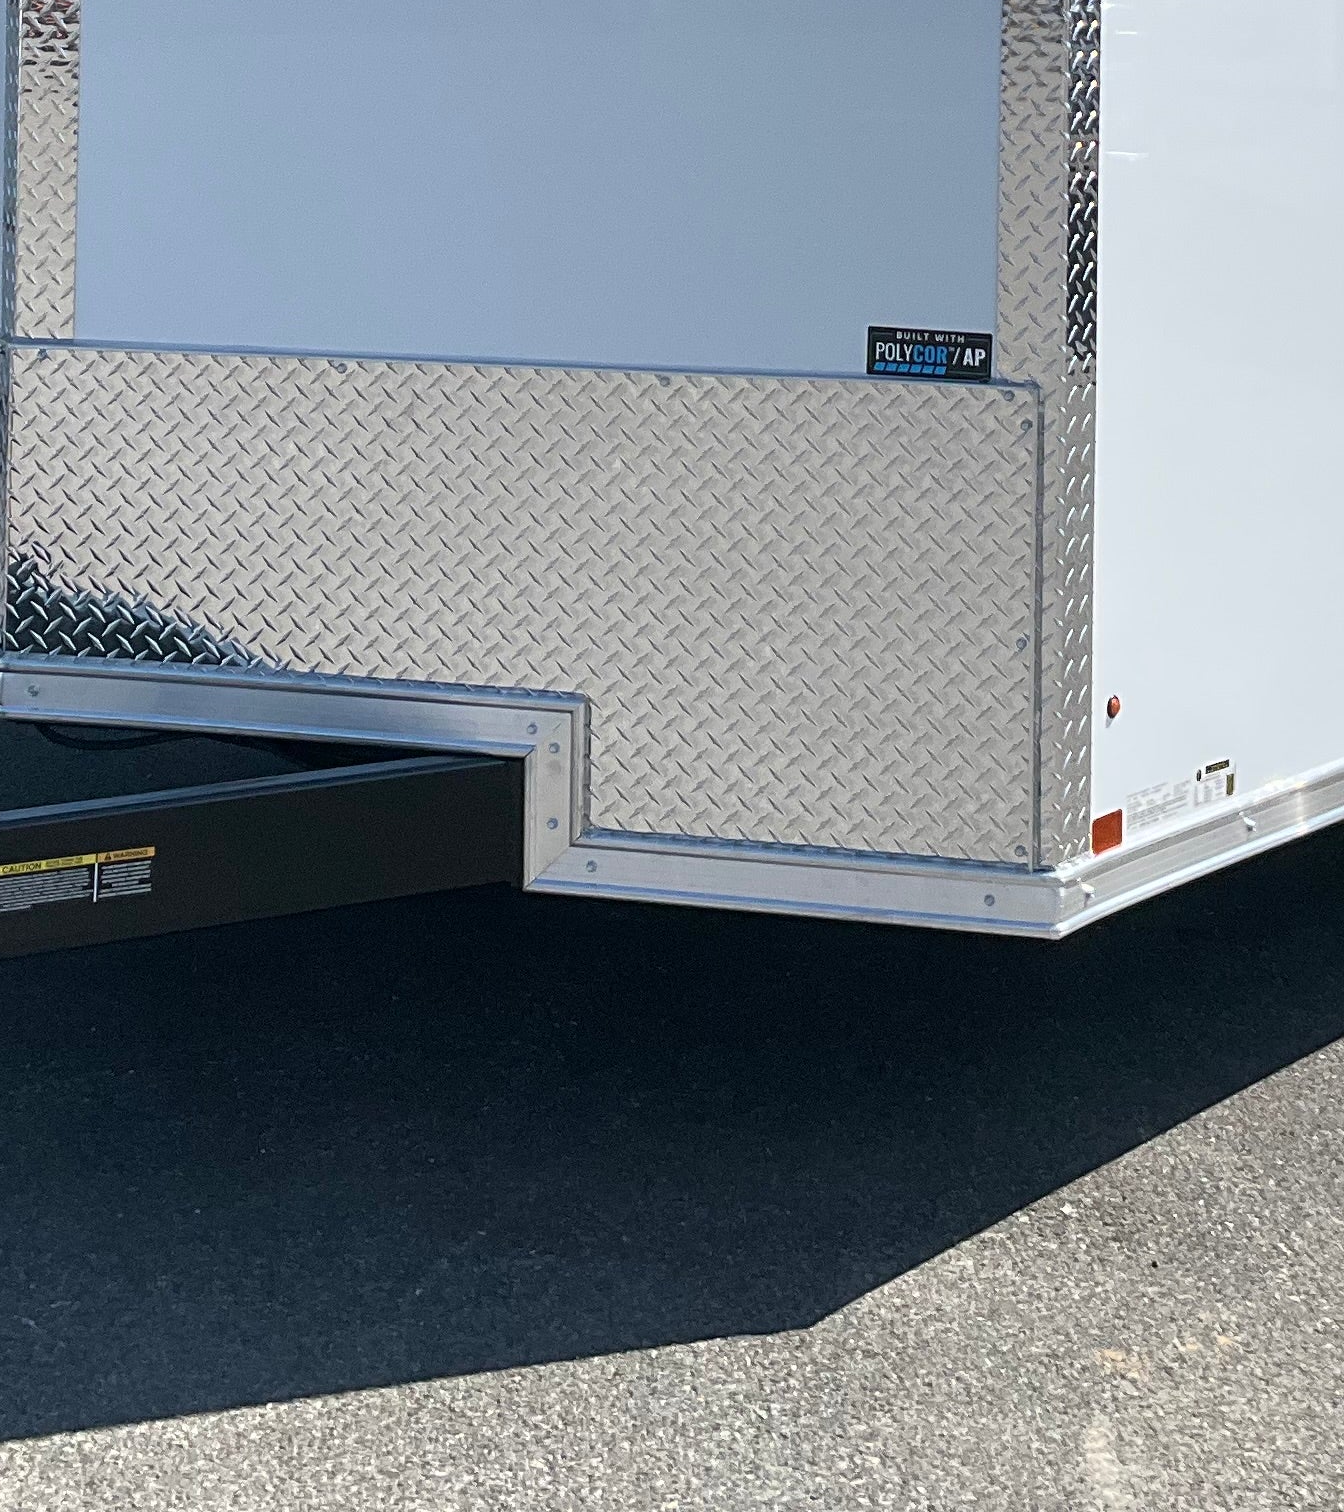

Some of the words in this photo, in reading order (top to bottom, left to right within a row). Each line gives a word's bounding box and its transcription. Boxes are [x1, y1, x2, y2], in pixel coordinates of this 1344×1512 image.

[896, 331, 930, 341] BUILT
[934, 333, 965, 343] WITH
[2, 863, 42, 874] CAUTION
